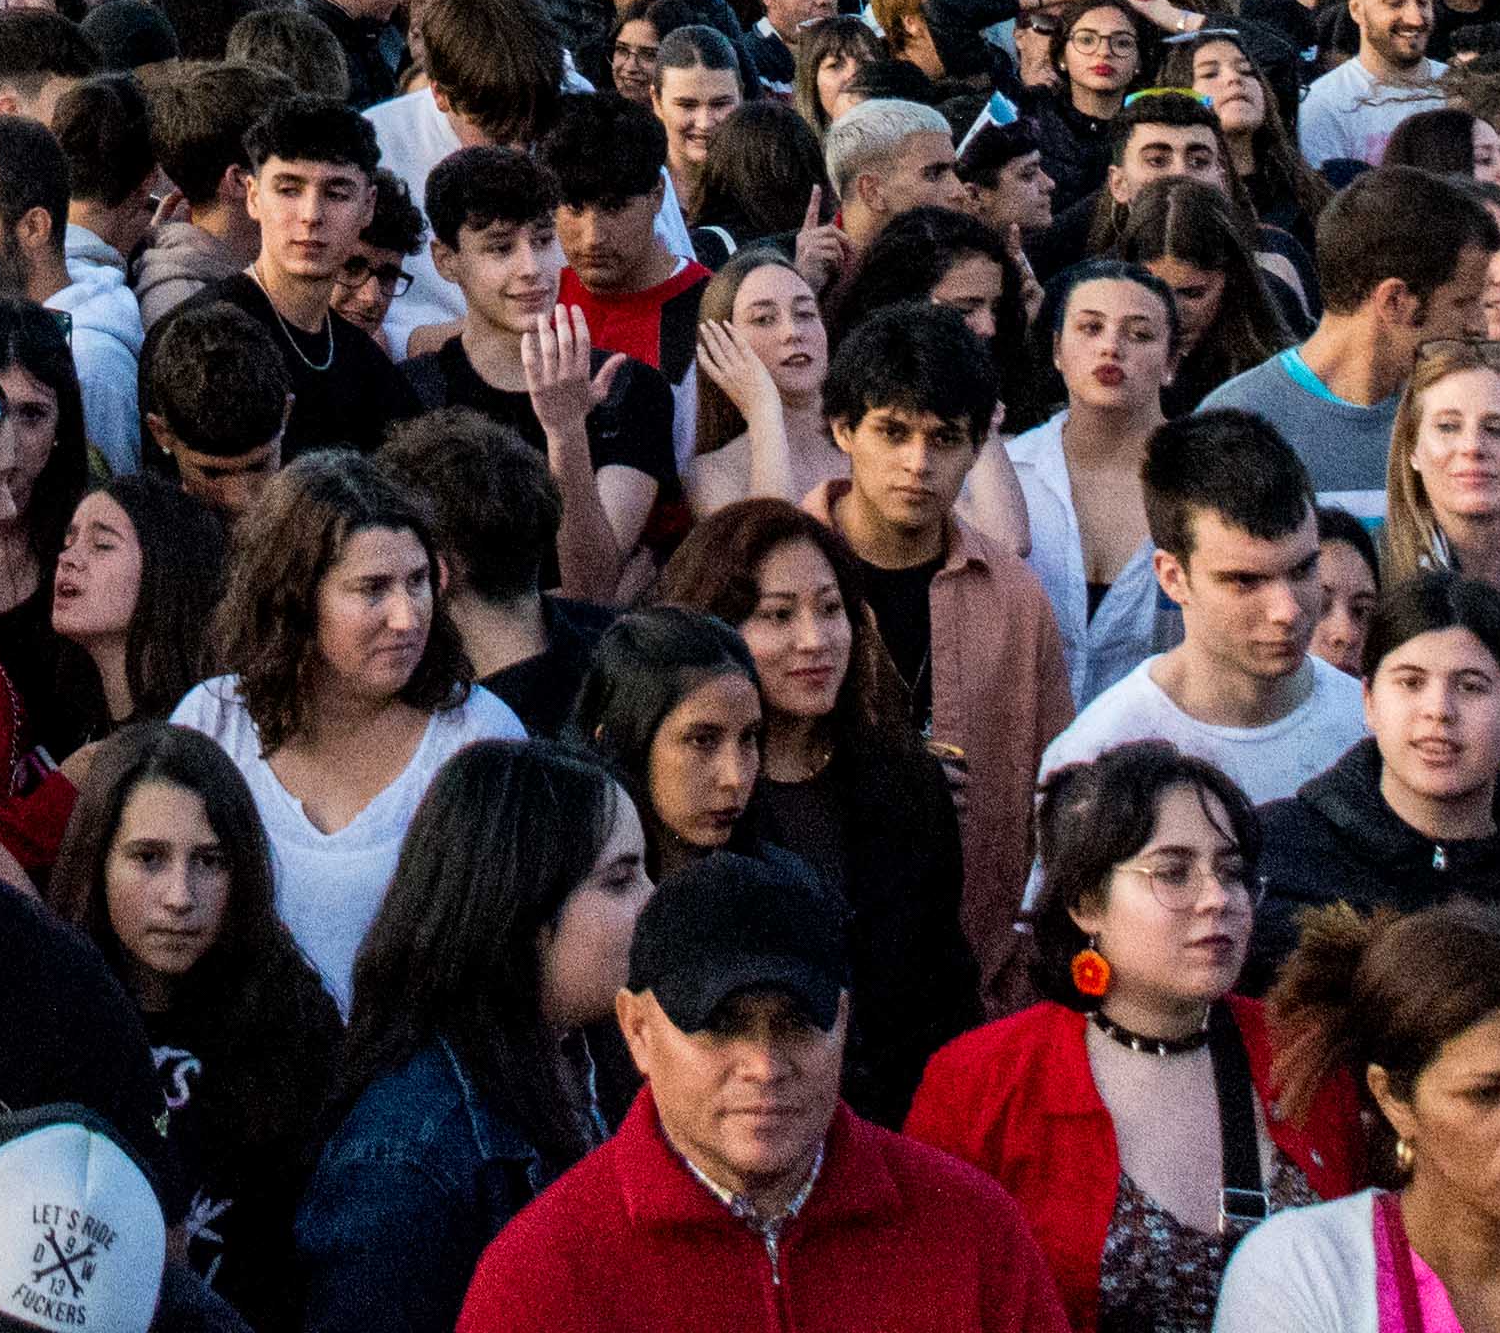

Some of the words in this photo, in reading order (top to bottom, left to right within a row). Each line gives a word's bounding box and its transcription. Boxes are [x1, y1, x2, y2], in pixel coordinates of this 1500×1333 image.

[32, 1204, 81, 1231] LET'S
[81, 1215, 119, 1251] RIDE
[11, 1283, 87, 1326] FUCKERS
[49, 1276, 66, 1297] 13
